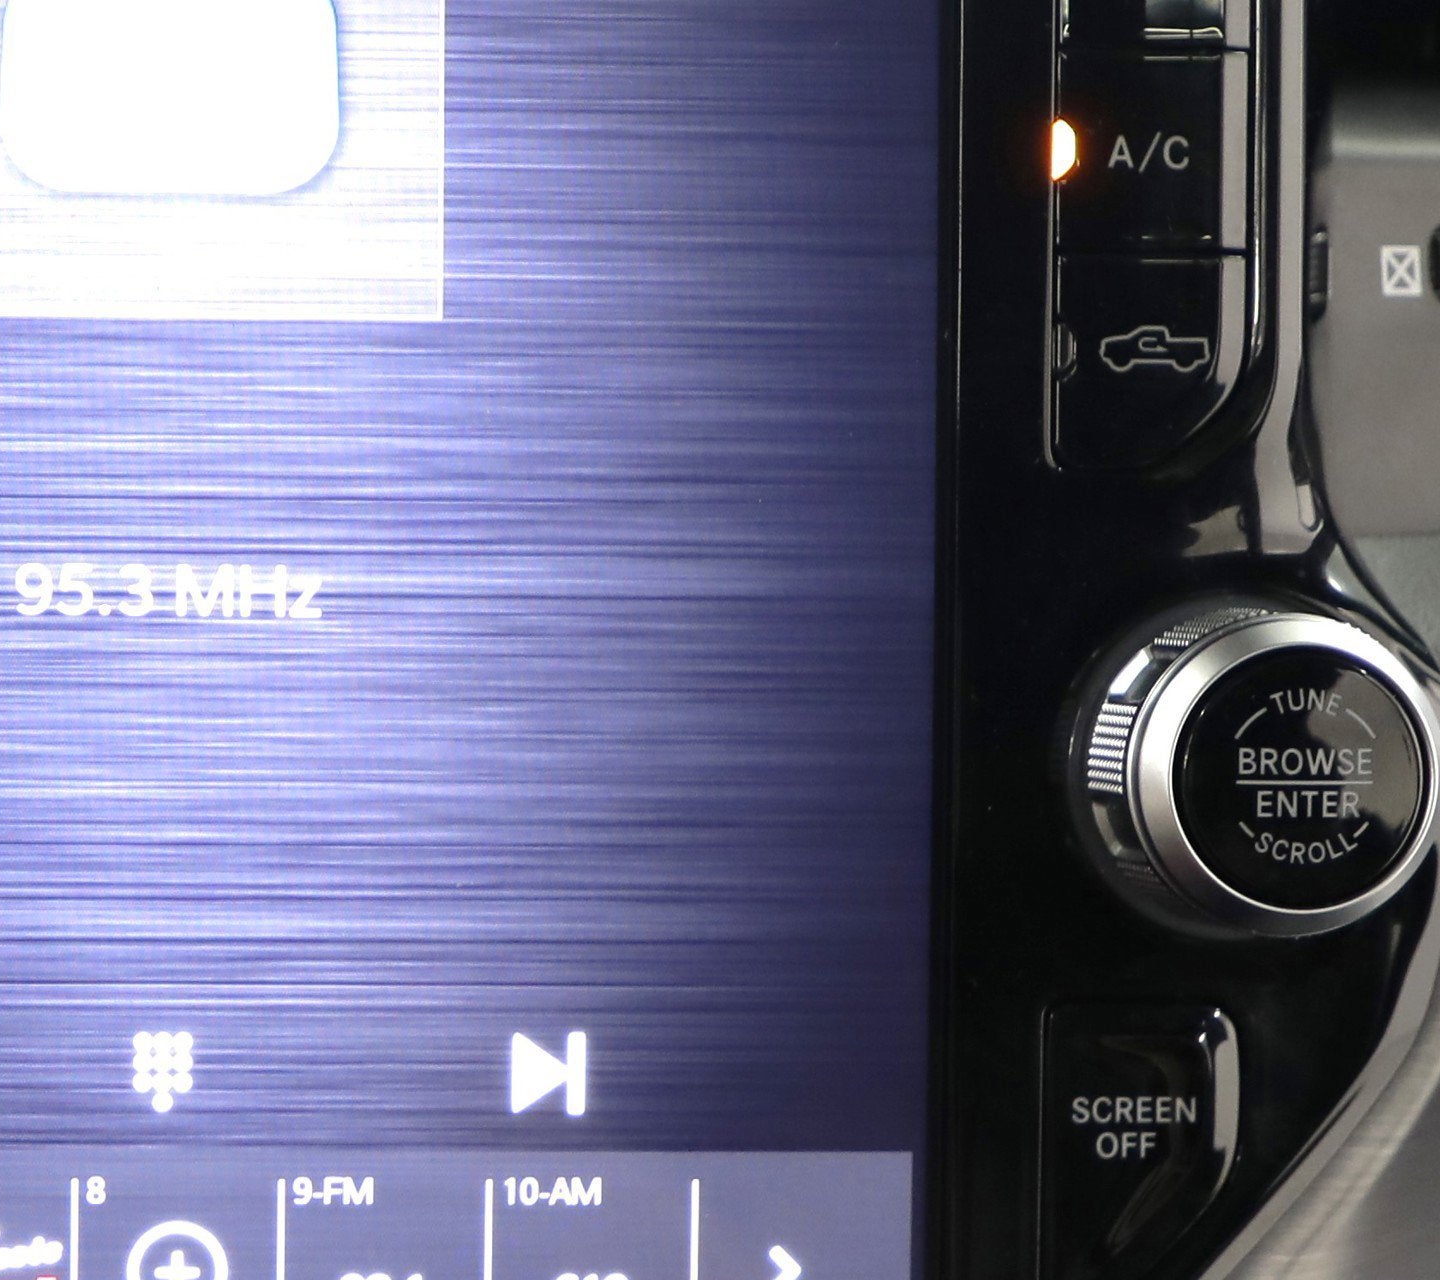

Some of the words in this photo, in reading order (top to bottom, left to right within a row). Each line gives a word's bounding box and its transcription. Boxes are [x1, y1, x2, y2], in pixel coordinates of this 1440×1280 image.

[1107, 131, 1191, 174] A/C
[12, 560, 155, 620] 95.3
[172, 560, 324, 621] MHz
[1271, 688, 1342, 715] TUNE
[1238, 748, 1372, 776] BROWSE
[1257, 790, 1360, 818] ENTER
[1254, 830, 1359, 865] SCROLL
[1072, 1097, 1196, 1124] SCREEN
[1096, 1132, 1156, 1159] OFF
[85, 1176, 106, 1205] 8
[292, 1176, 374, 1205] 9-FM
[504, 1176, 602, 1206] 10-AM
